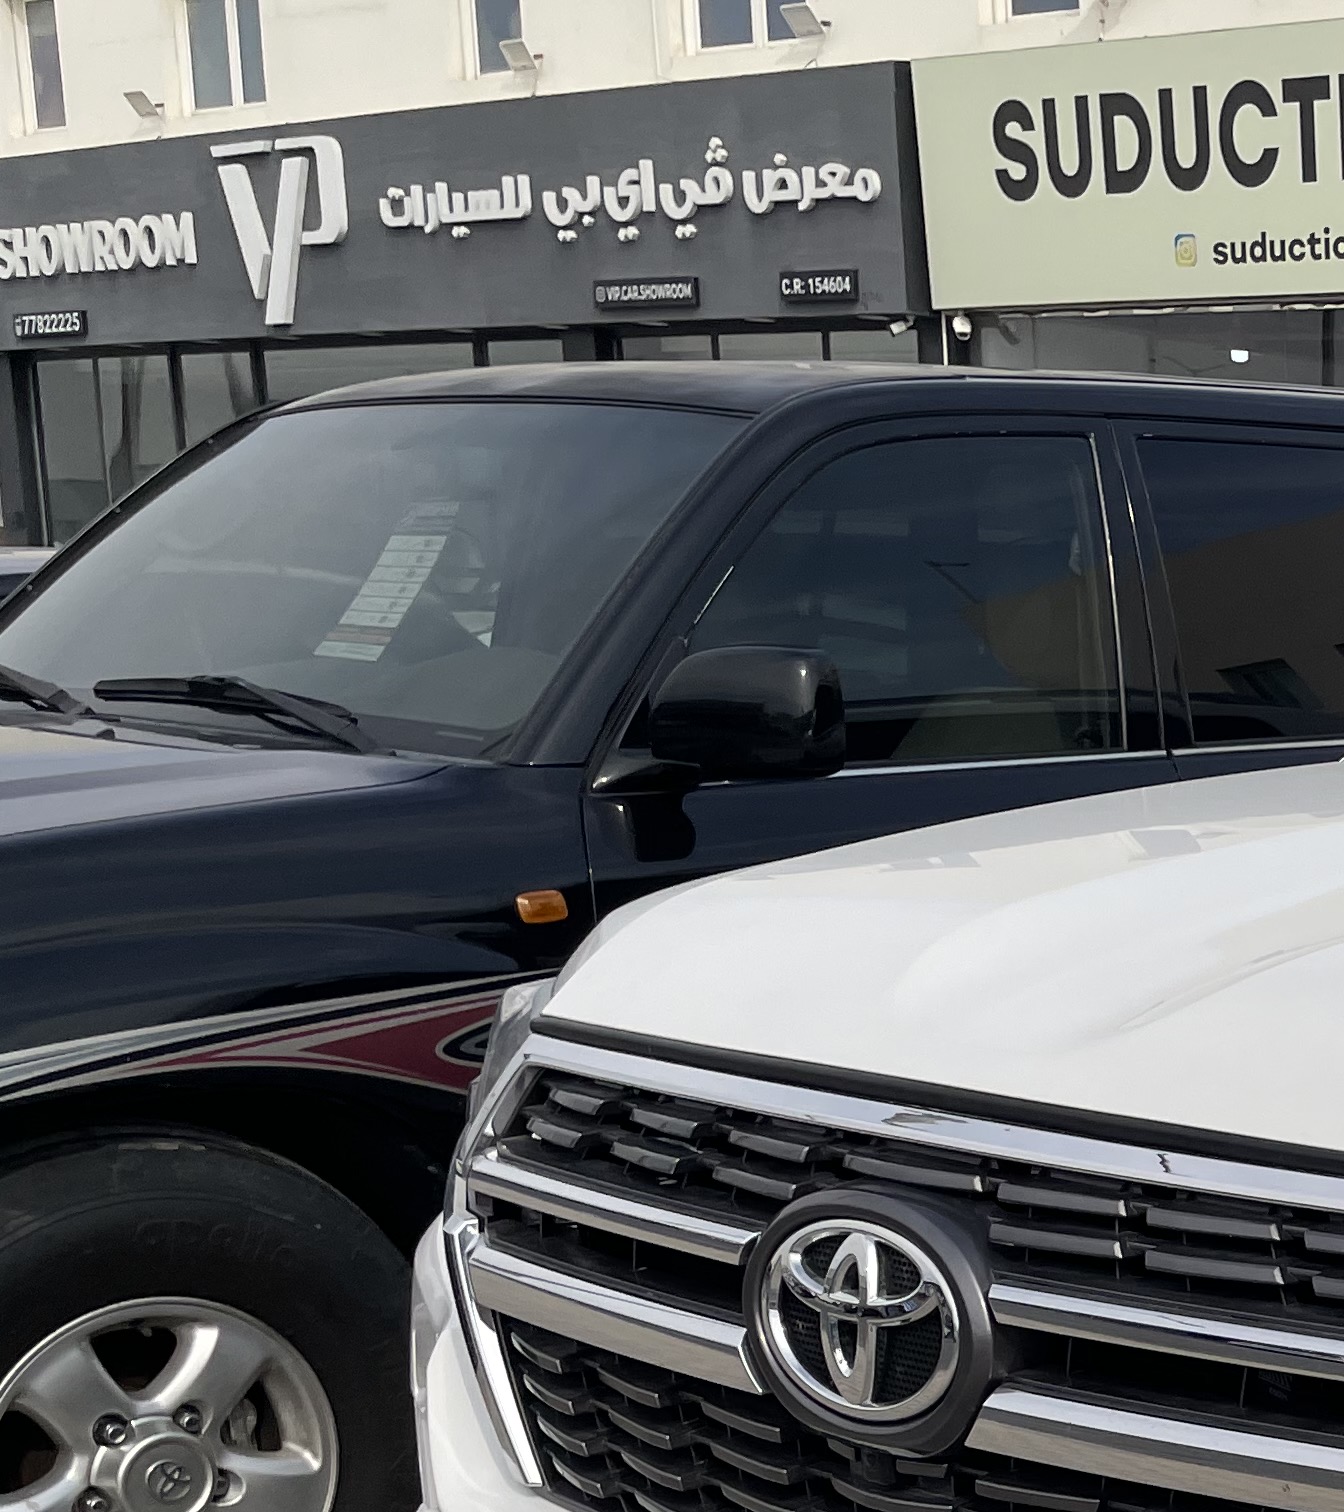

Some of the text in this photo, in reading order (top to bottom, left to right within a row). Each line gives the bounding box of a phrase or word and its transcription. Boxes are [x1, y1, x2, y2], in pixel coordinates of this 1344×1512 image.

[379, 173, 533, 240] للسيارات
[741, 152, 883, 215] معرض
[0, 211, 198, 280] SHOWROOM
[808, 275, 852, 295] 154604
[22, 311, 82, 335] 77822225
